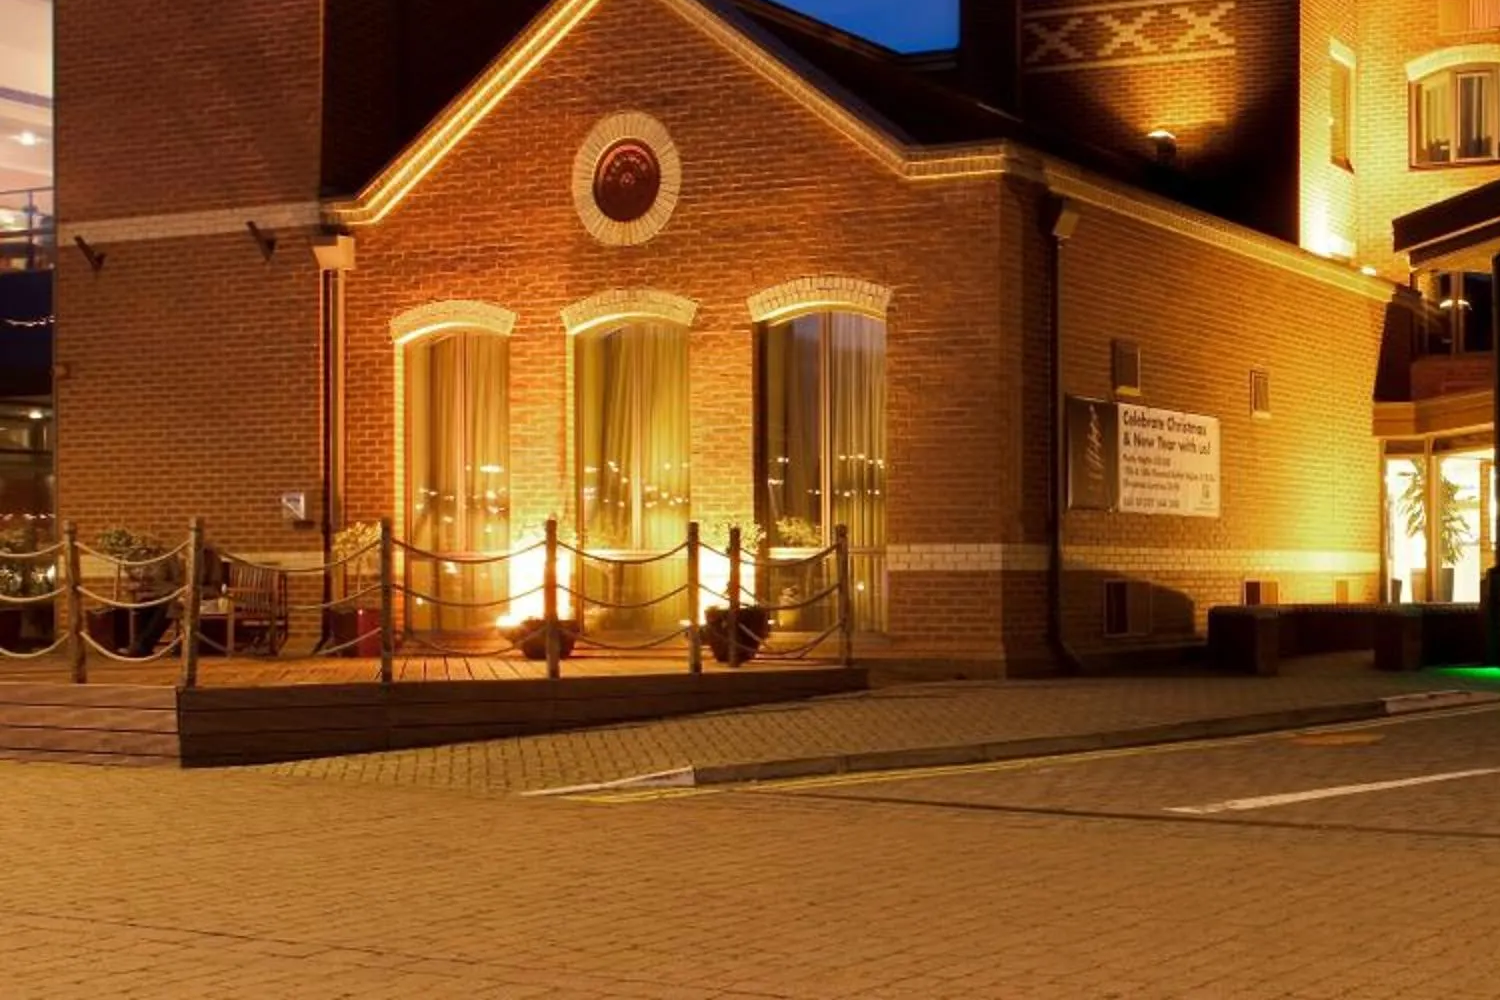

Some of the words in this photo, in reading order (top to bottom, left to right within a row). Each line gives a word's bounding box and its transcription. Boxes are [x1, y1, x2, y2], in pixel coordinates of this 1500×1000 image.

[1123, 410, 1164, 430] Celebrate
[1167, 417, 1207, 436] Christmas
[1123, 432, 1131, 446] &
[1133, 432, 1154, 447] New
[1157, 436, 1176, 451] Year
[1178, 437, 1197, 453] with
